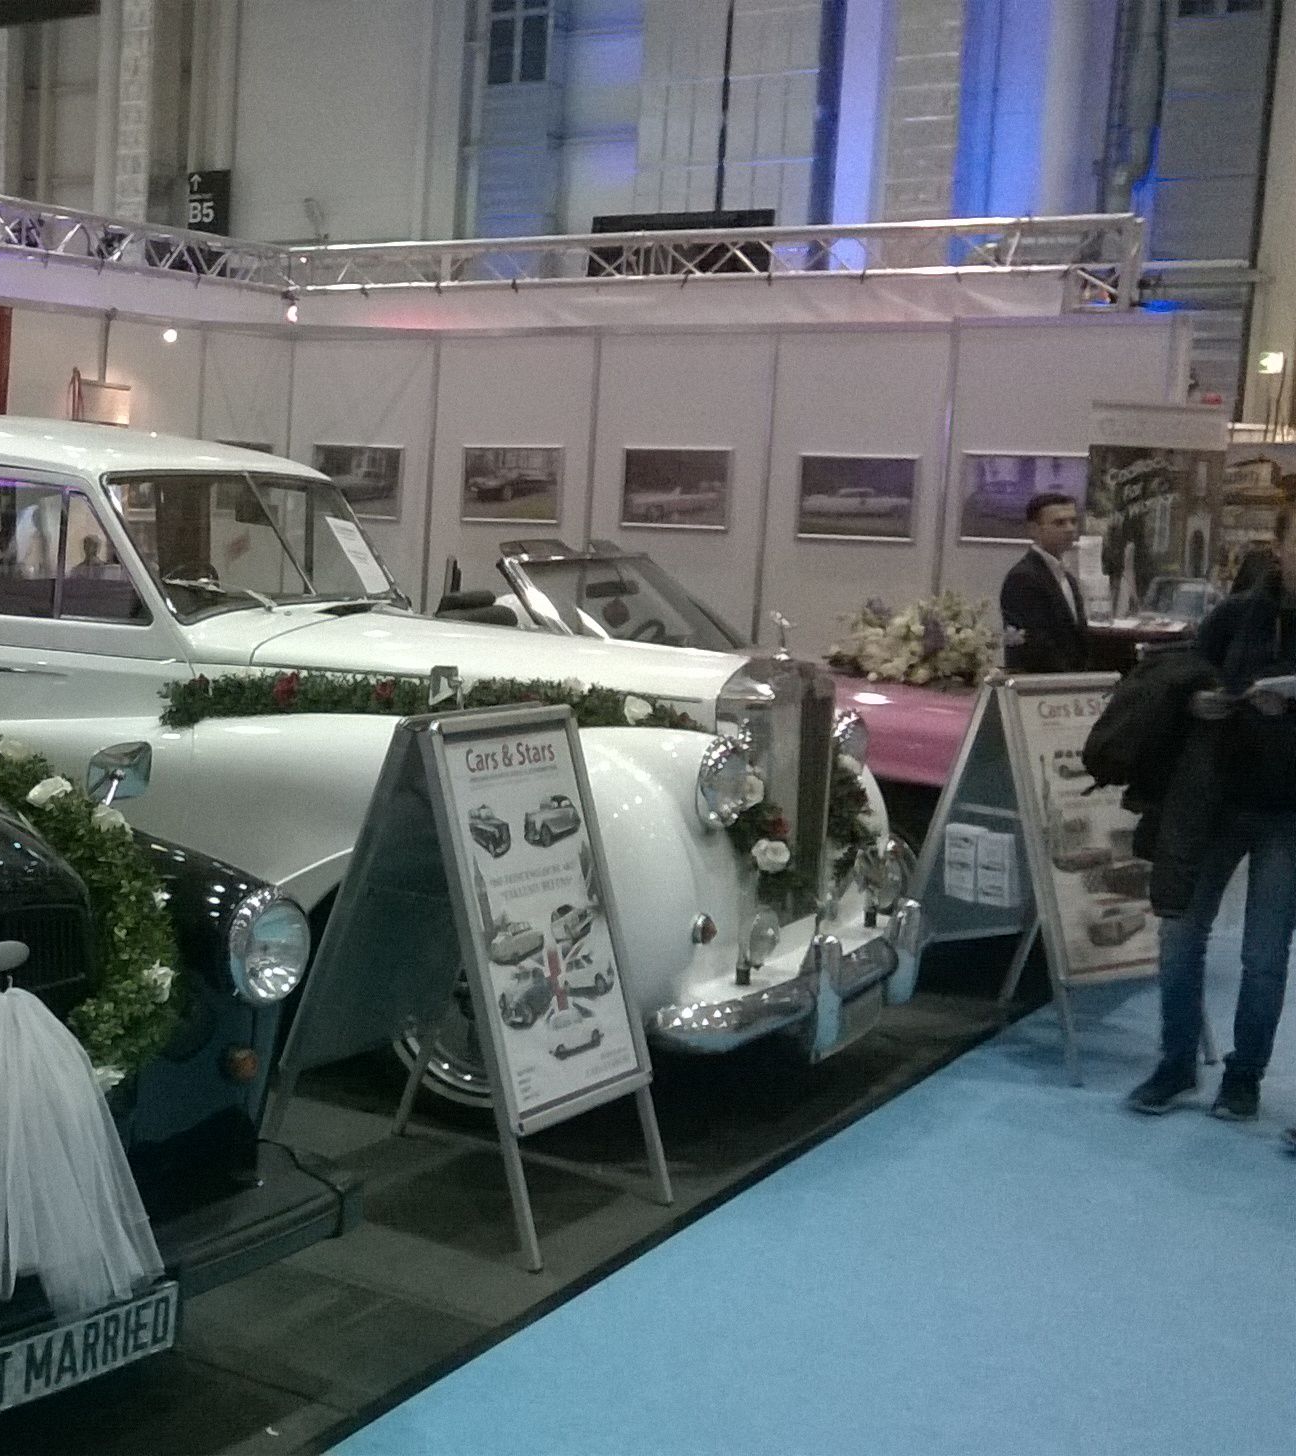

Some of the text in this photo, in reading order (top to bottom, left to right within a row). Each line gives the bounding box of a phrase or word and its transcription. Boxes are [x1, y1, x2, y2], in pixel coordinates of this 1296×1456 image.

[189, 201, 215, 223] B5
[465, 742, 555, 773] Cars & Stars
[23, 1295, 171, 1395] MARRIED
